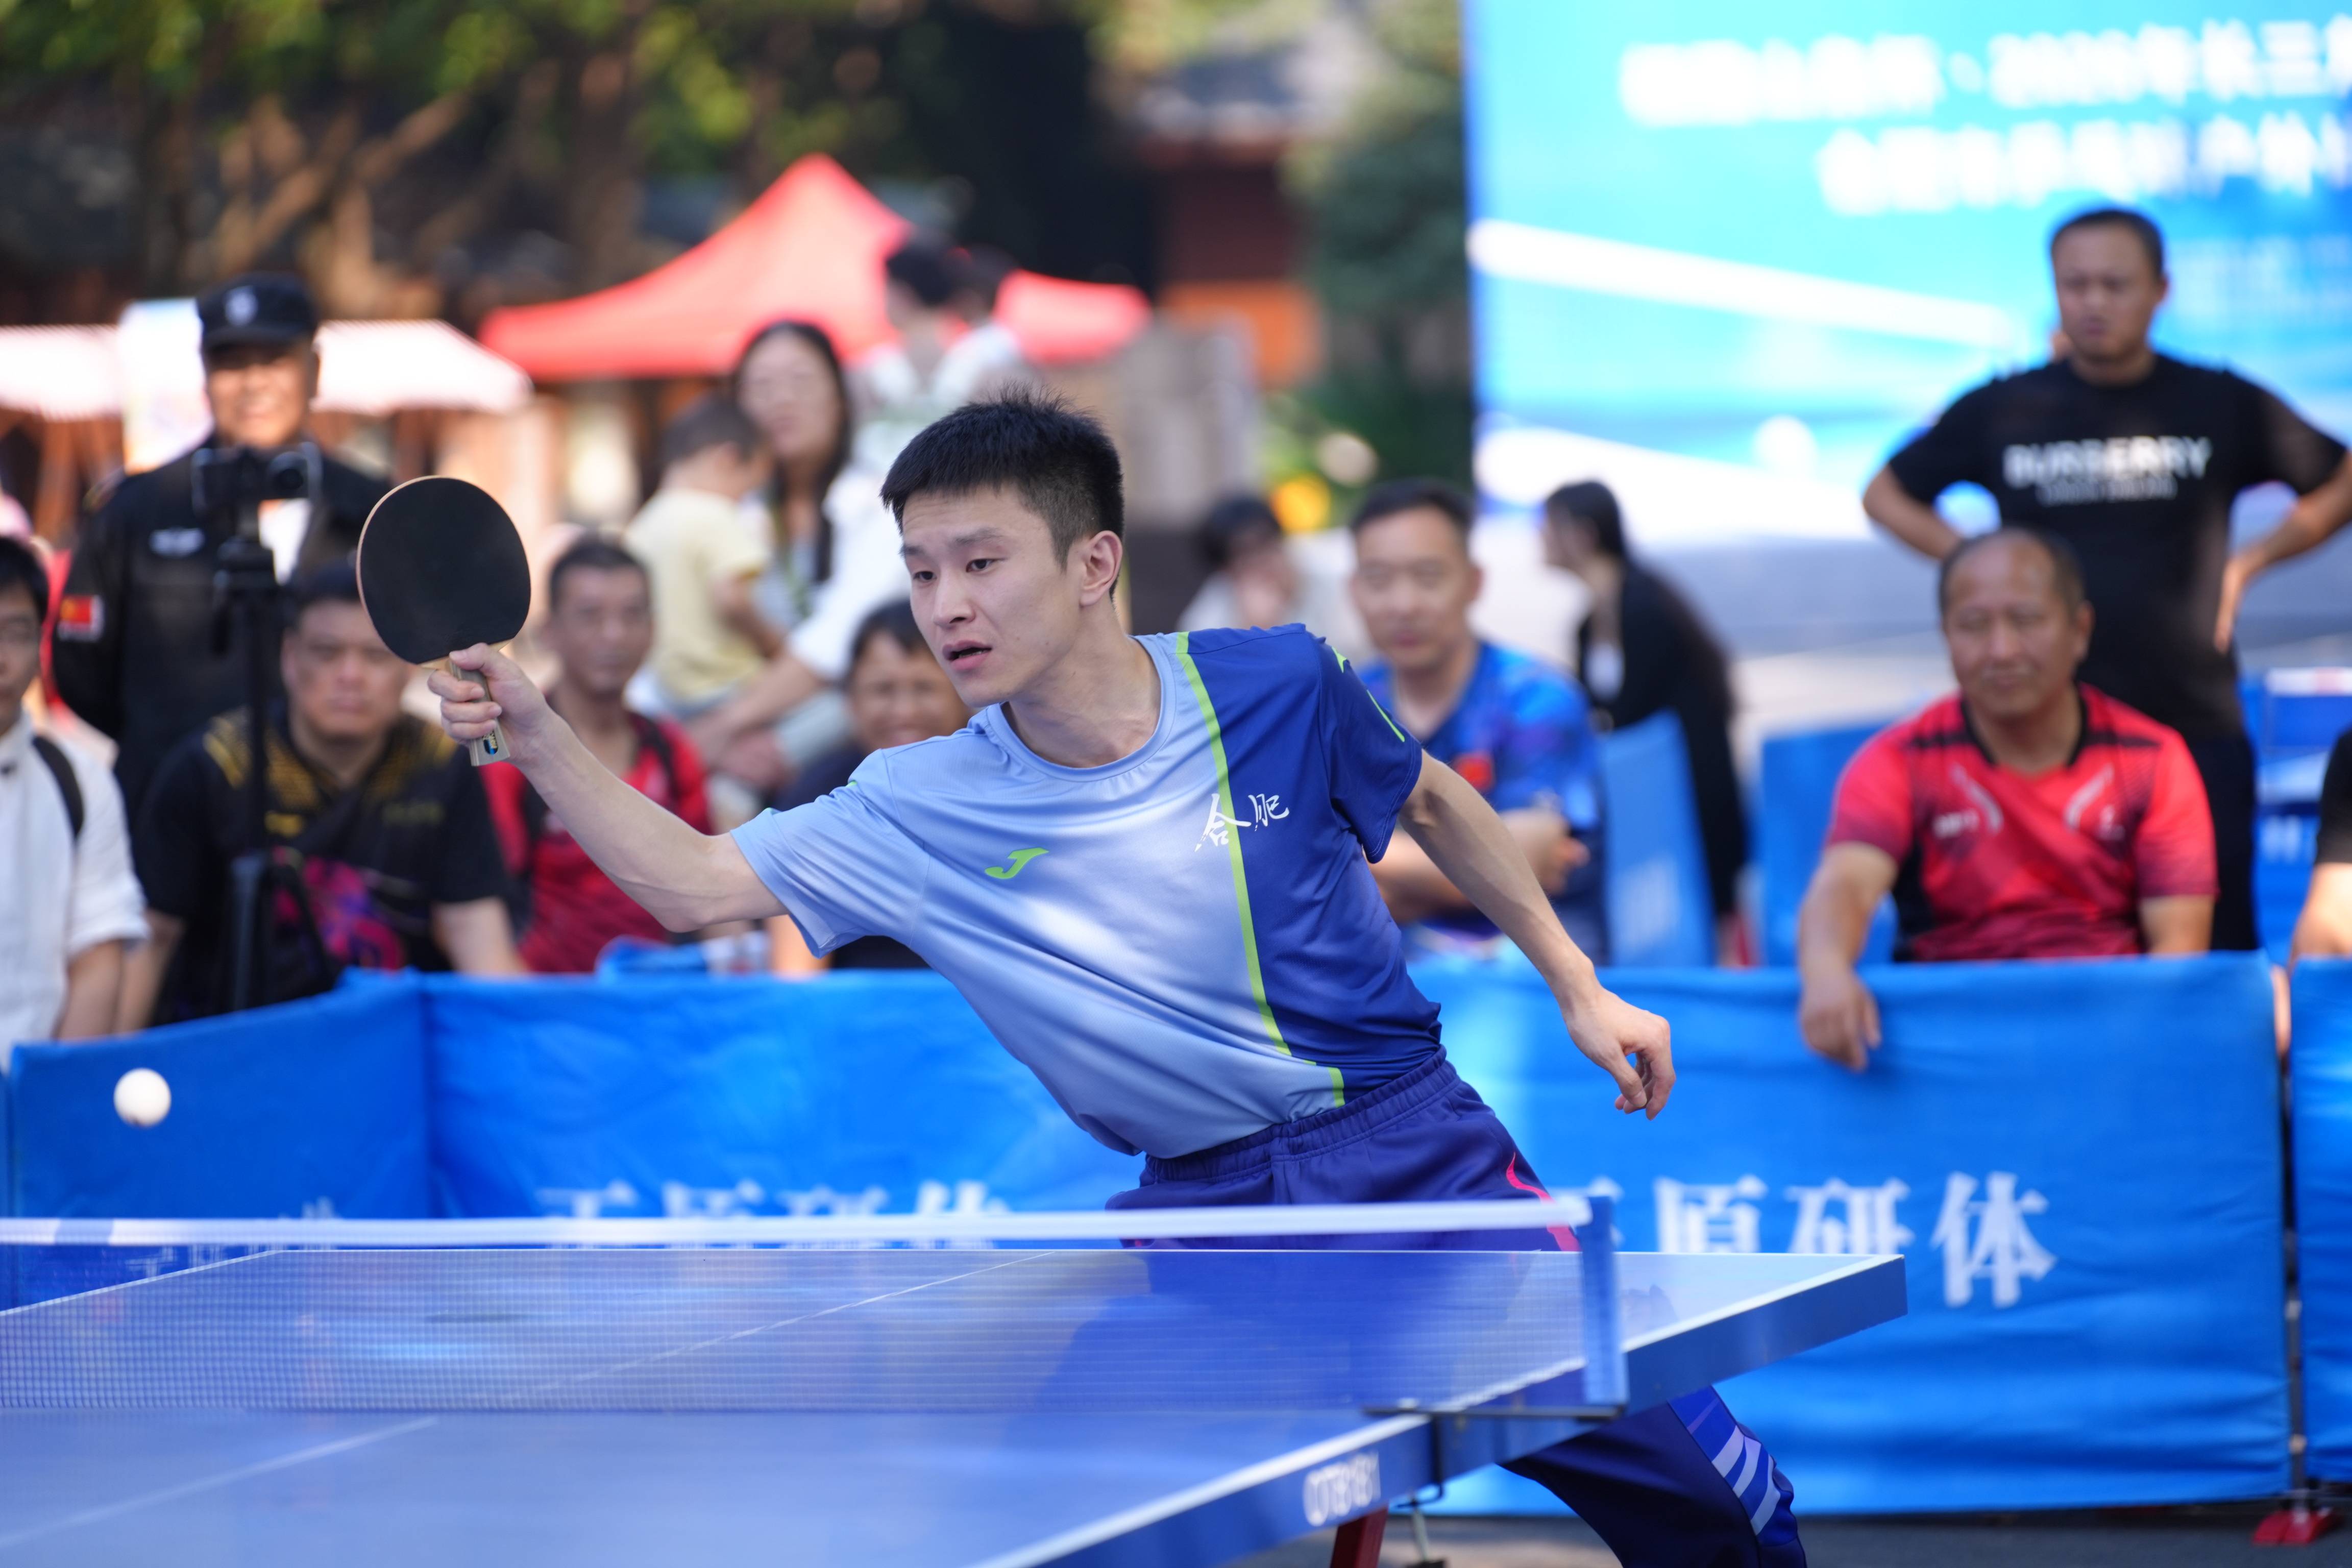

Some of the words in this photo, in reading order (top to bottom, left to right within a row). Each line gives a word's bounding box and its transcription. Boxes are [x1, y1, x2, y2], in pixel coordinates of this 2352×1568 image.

[1194, 793, 1289, 852] 合肥
[1550, 1171, 2059, 1309] 原研体
